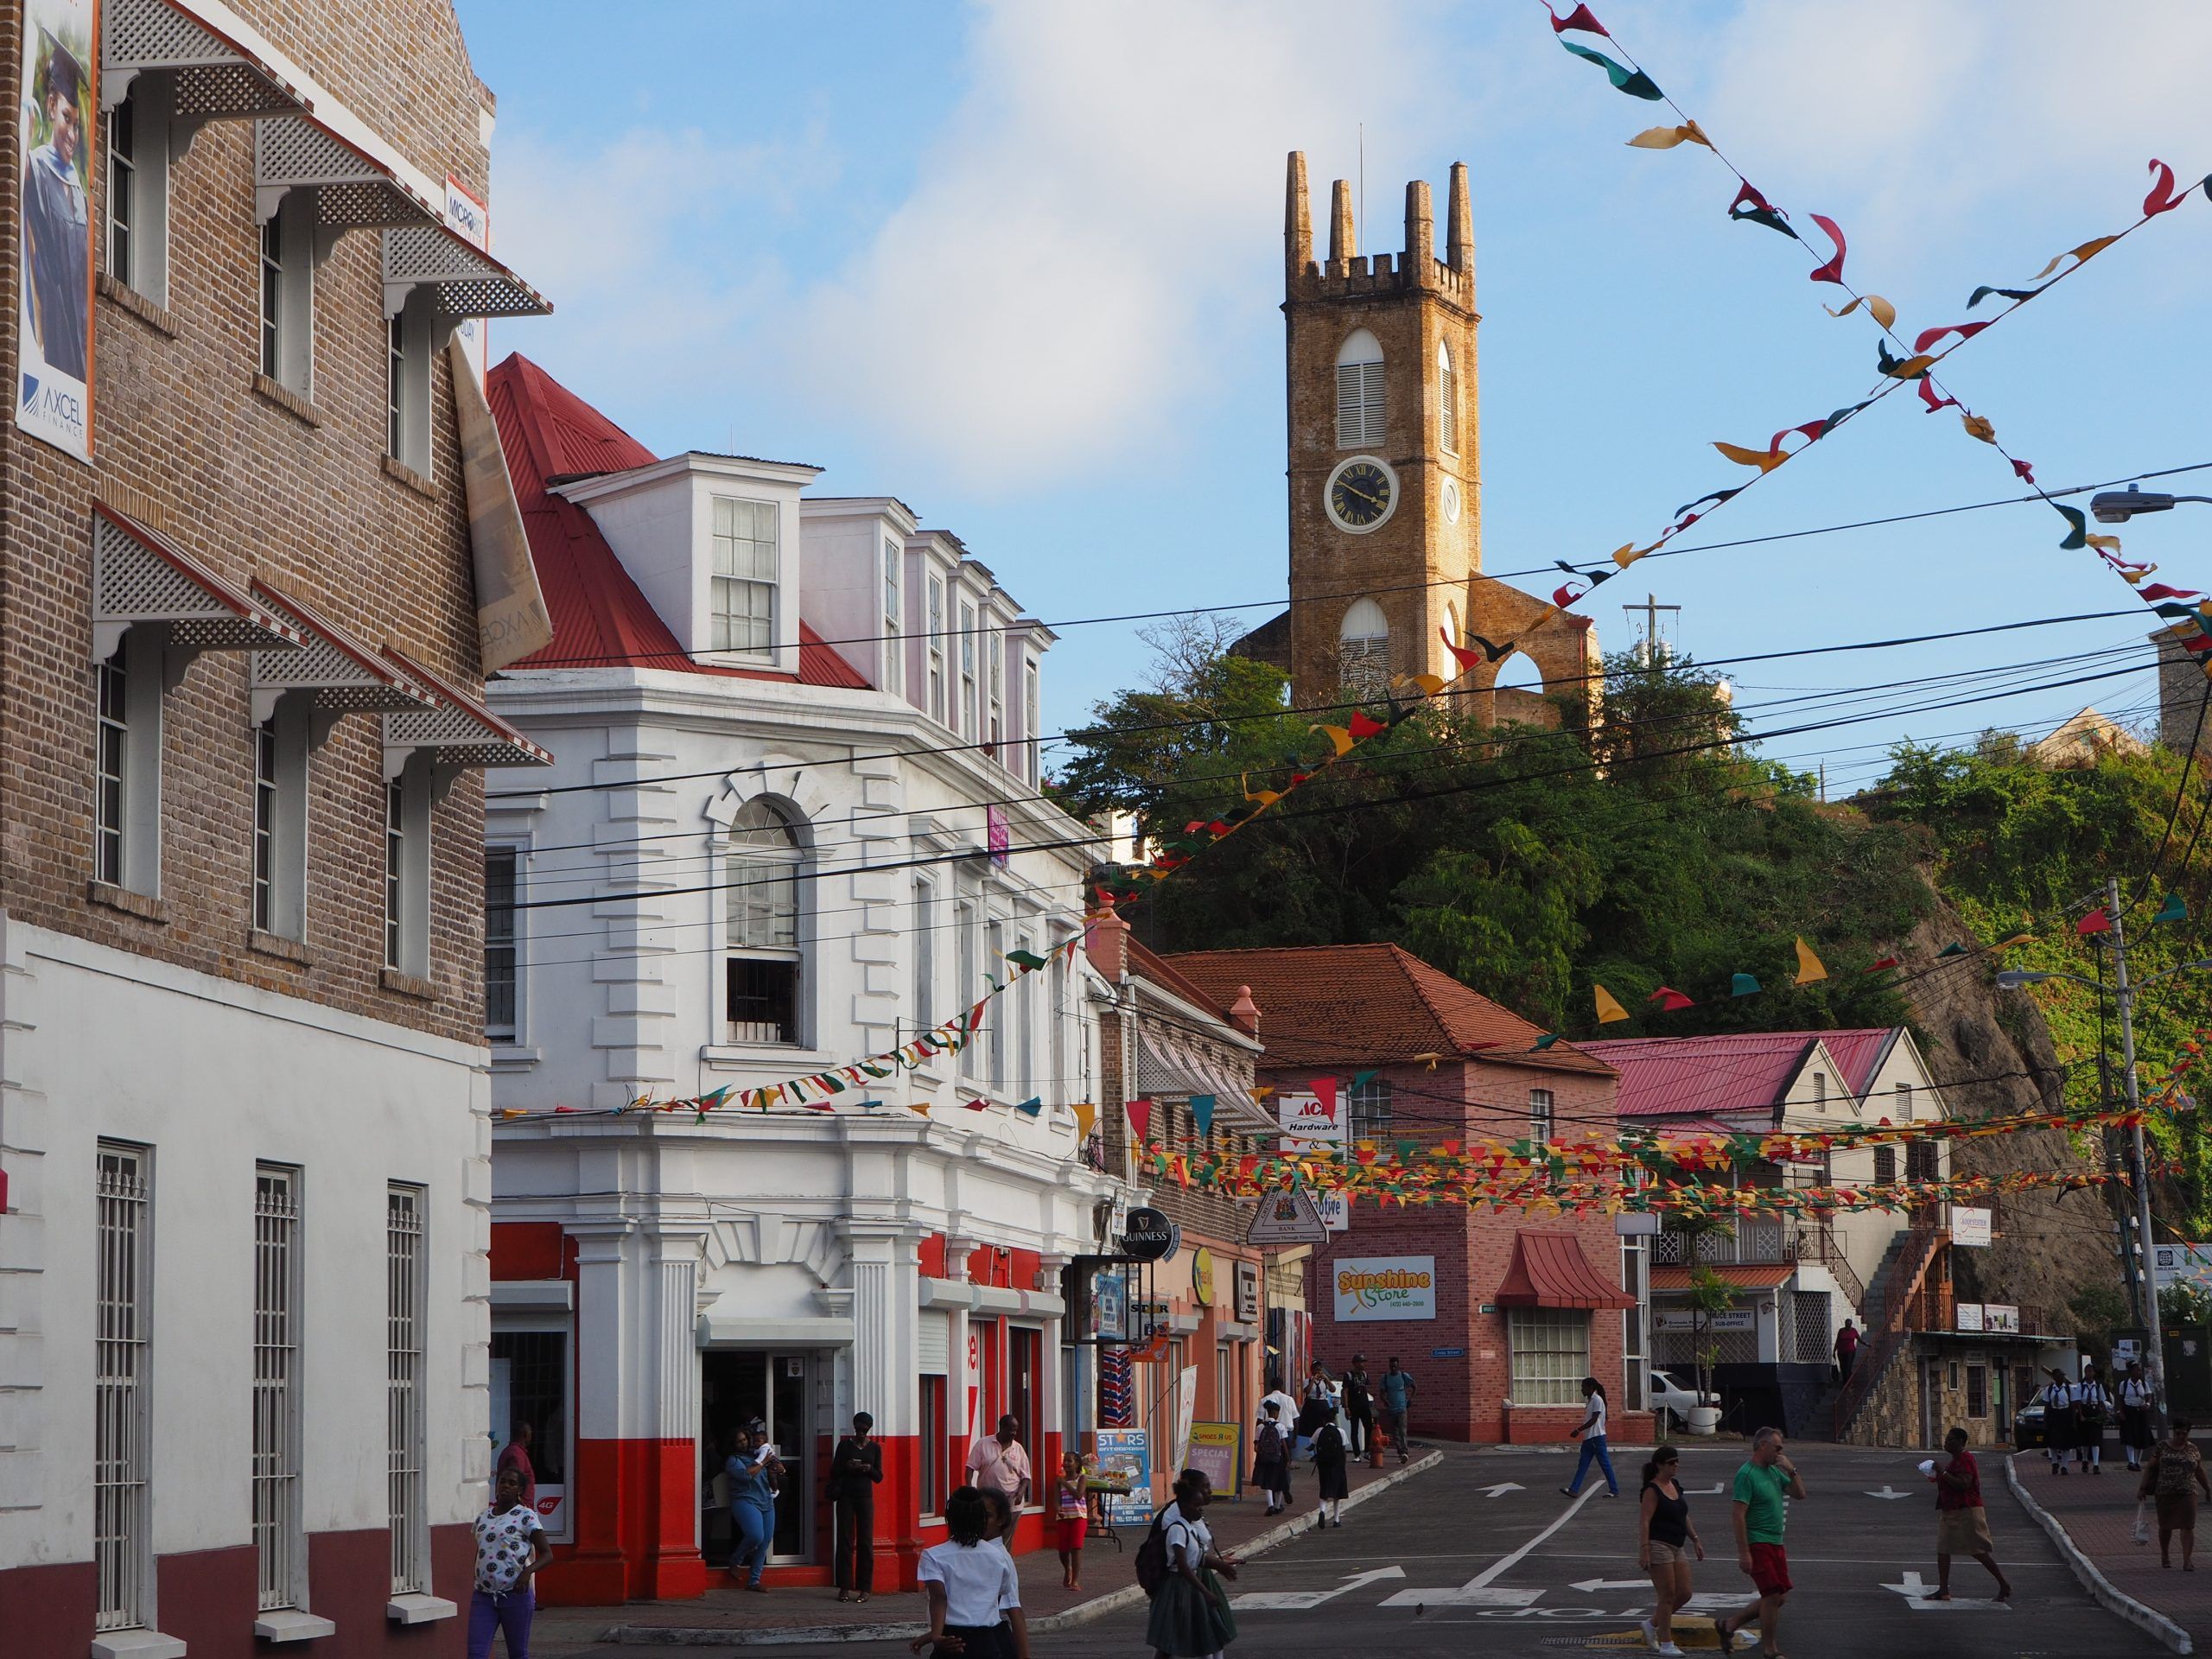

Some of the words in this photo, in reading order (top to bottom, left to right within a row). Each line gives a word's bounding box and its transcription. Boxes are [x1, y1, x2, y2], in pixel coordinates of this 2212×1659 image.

[43, 386, 82, 426] AXCEL
[42, 411, 83, 439] FINANCE
[1309, 1138, 1320, 1149] &
[1261, 1193, 1275, 1218] GRENAD
[1122, 1231, 1167, 1243] GUINNESS
[1338, 1268, 1431, 1290] Sunshine
[1364, 1284, 1409, 1307] Store
[1098, 1433, 1145, 1446] STRS
[1192, 1448, 1229, 1459] SPECIAL
[1198, 1459, 1221, 1468] SALE
